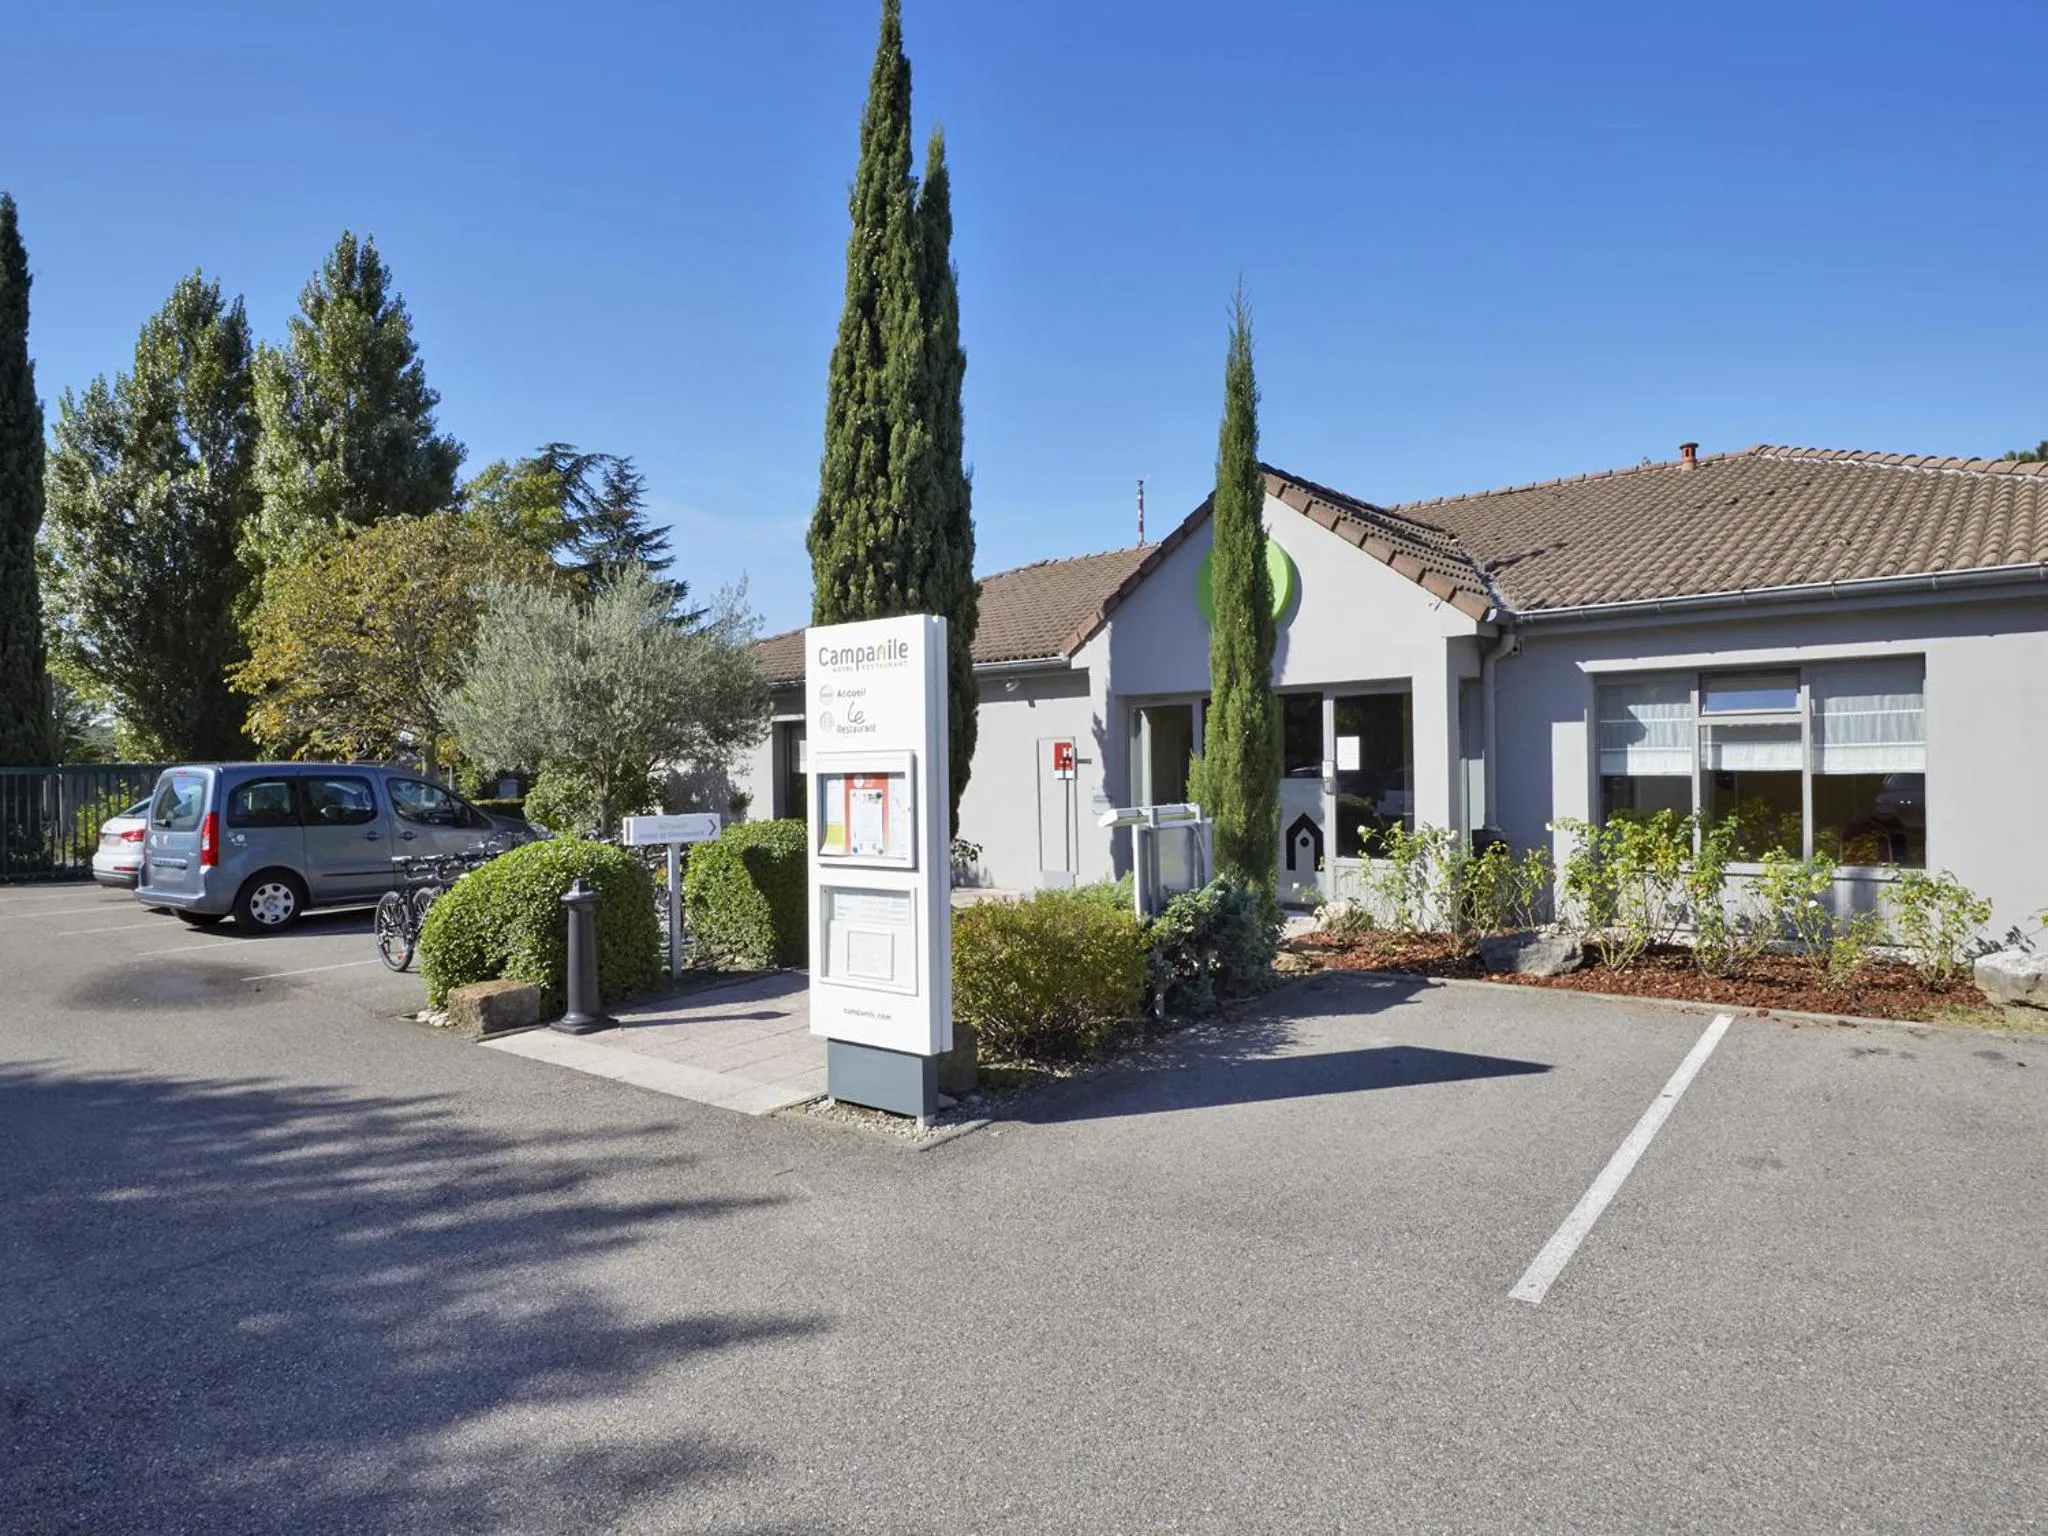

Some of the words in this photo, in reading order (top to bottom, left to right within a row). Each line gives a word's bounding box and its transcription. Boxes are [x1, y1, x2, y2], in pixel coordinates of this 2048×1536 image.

[818, 638, 909, 671] Campanile
[836, 688, 866, 698] Accueil
[836, 723, 876, 734] Restaurant
